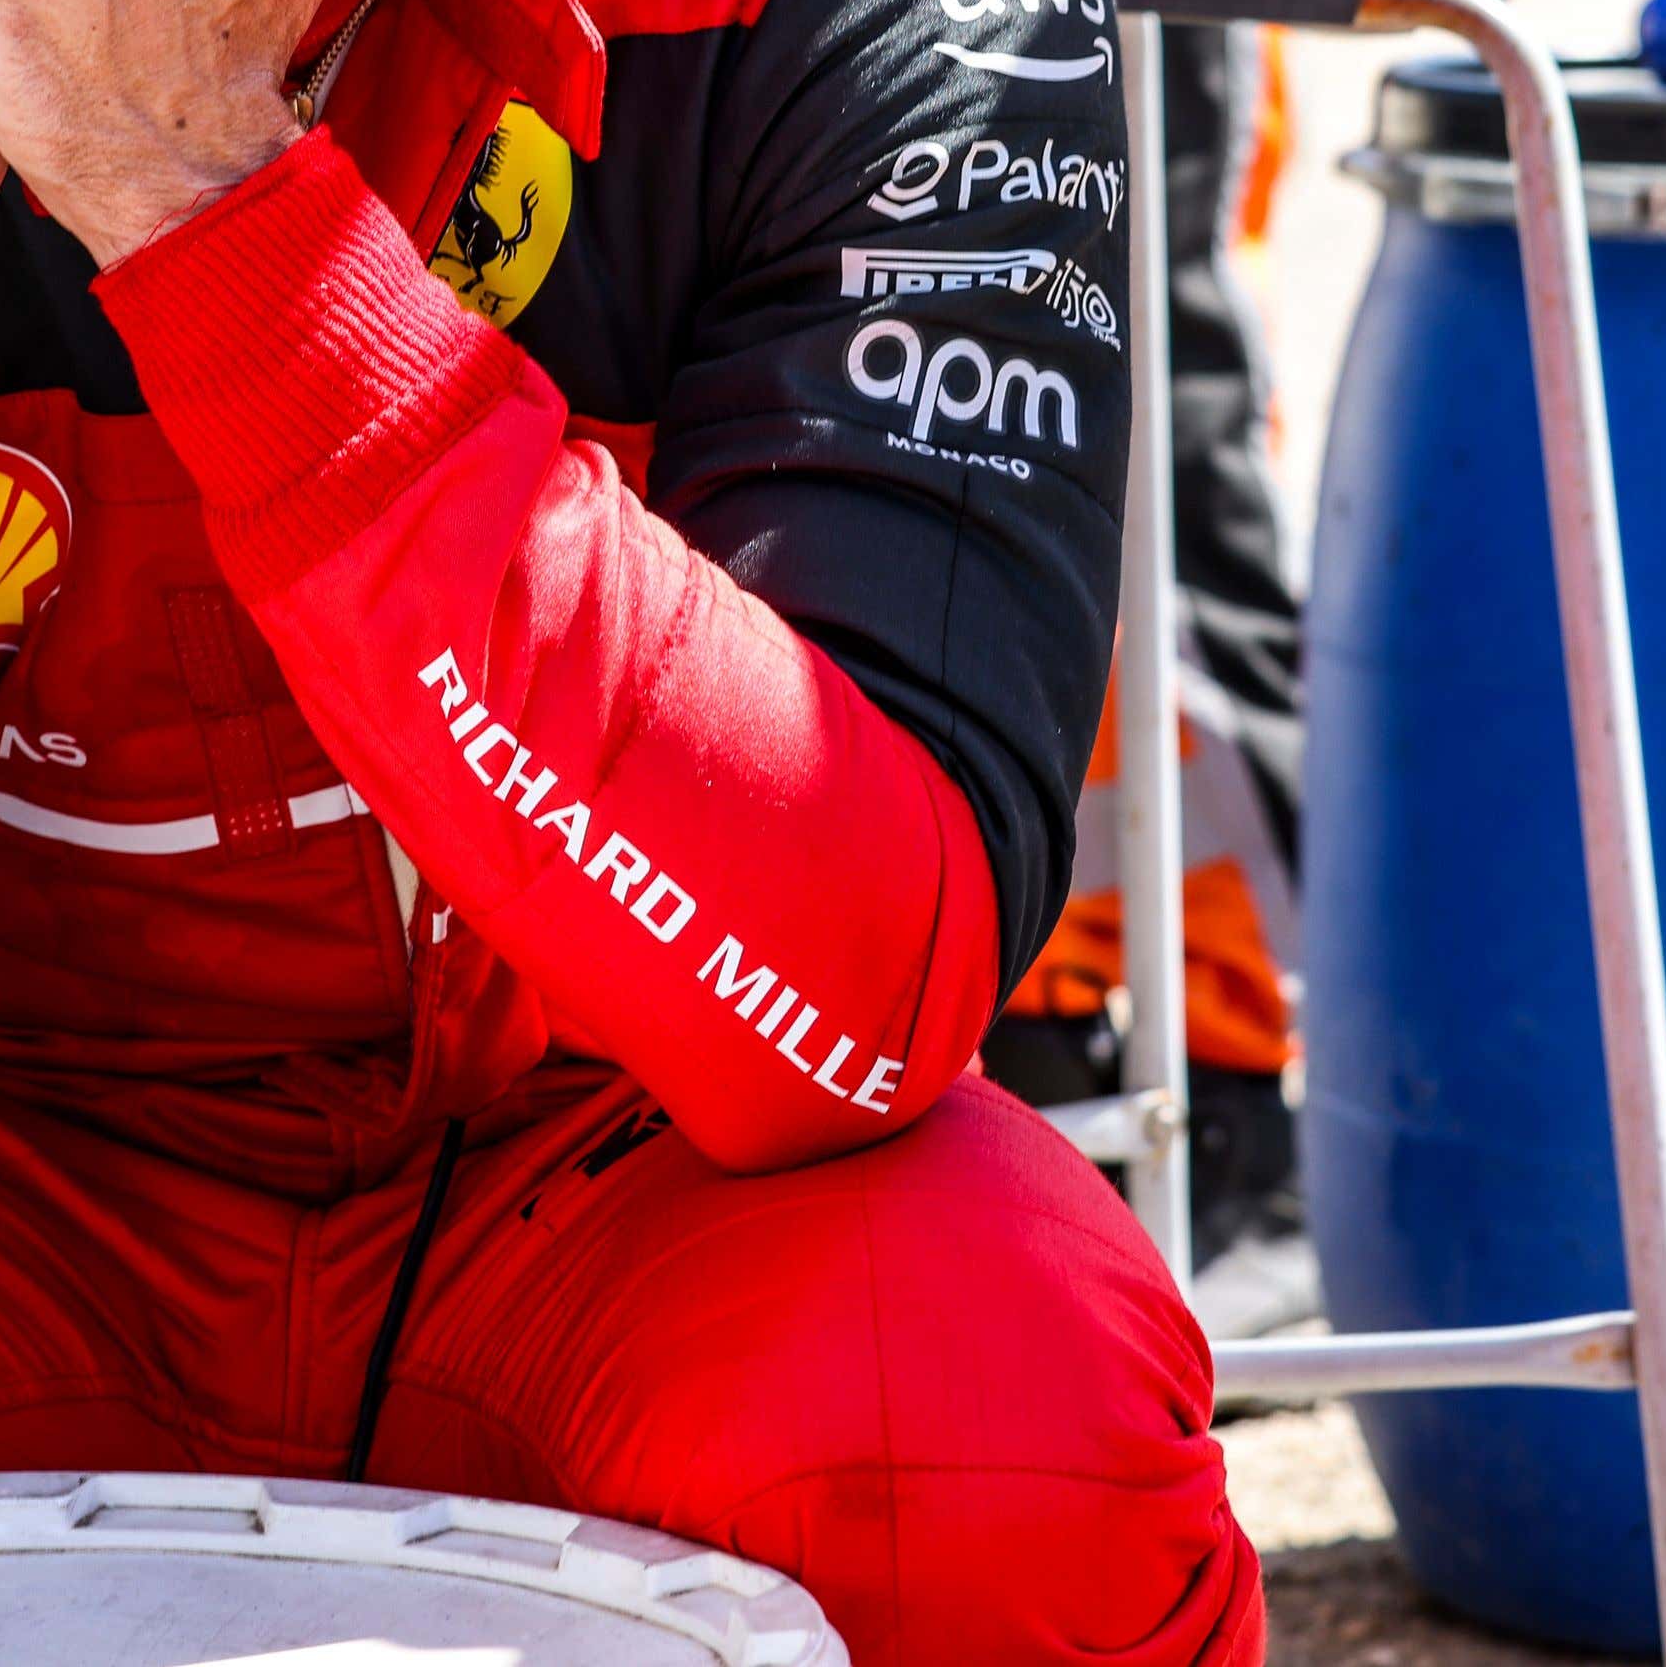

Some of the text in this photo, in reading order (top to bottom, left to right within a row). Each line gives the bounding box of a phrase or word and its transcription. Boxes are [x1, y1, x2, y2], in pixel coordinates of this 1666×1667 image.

[840, 246, 1057, 299] PIREL
[847, 319, 1077, 448] apm
[418, 647, 904, 1114] RICHARD MILLE
